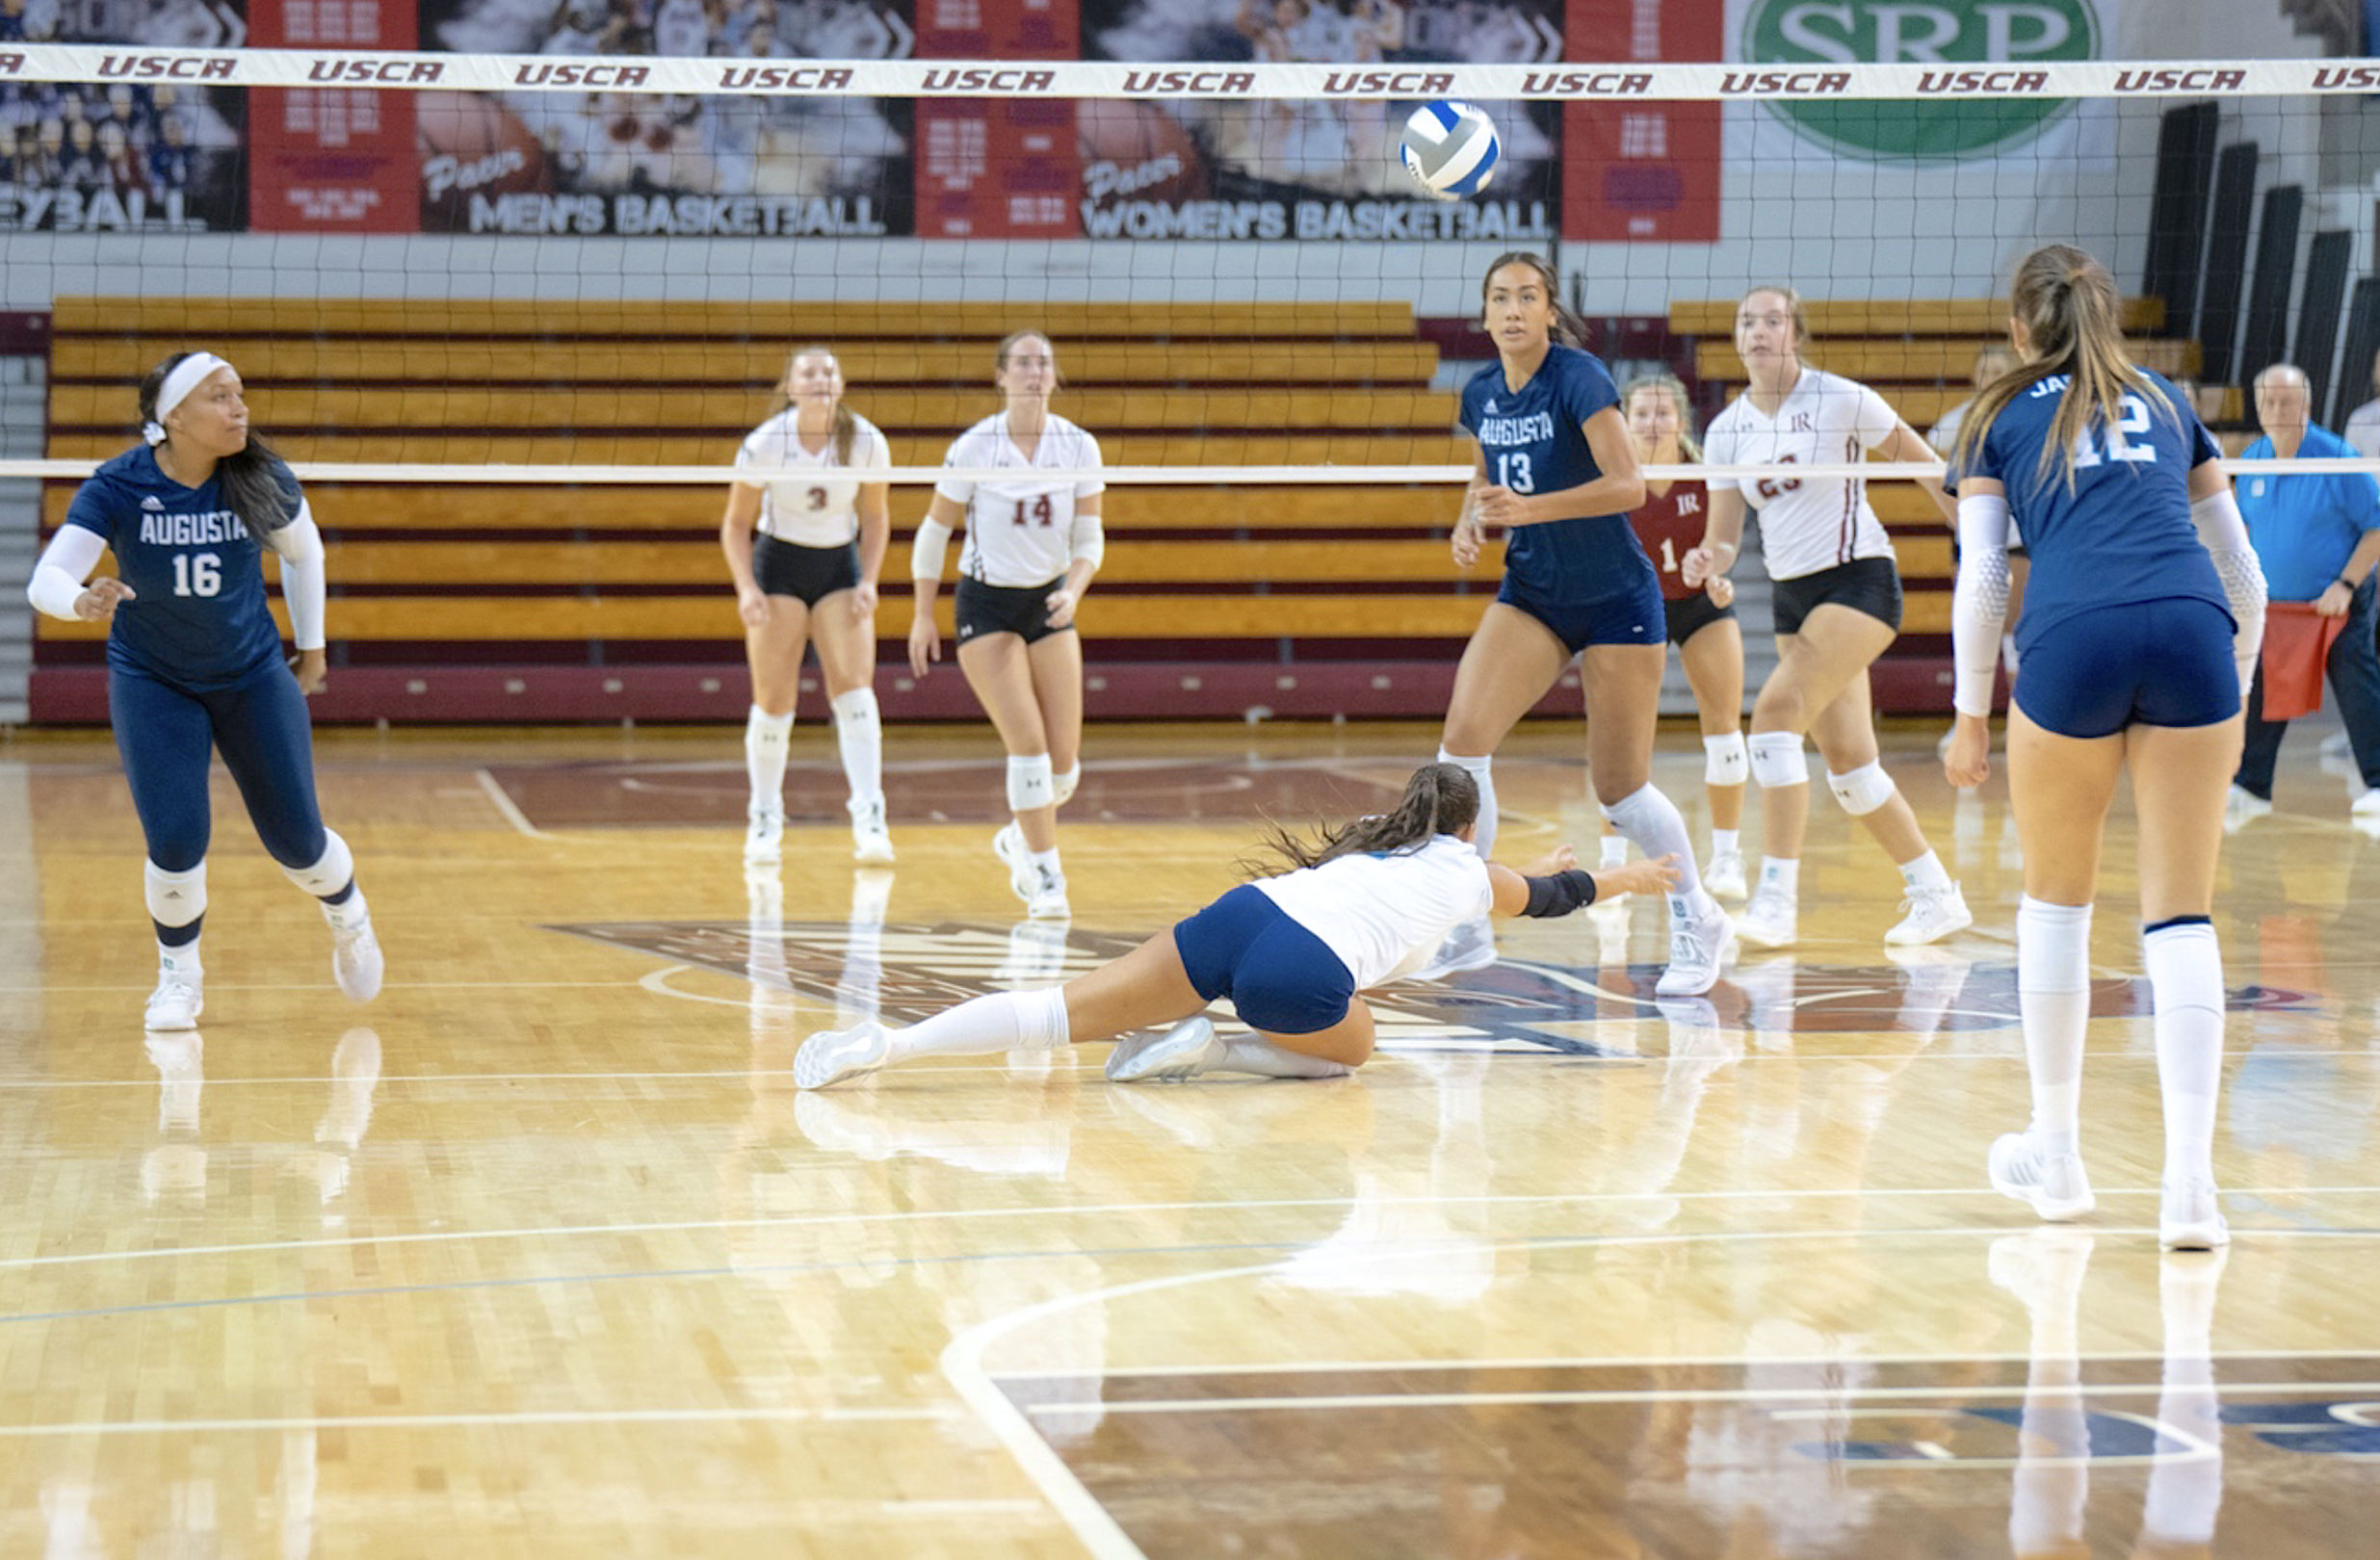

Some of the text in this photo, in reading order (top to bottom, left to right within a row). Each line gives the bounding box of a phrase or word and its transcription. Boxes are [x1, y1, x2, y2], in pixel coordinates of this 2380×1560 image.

[1778, 3, 2071, 64] SRP
[469, 193, 887, 236] MEN'S BASKETBALL
[1080, 198, 1287, 240] WOMEN'S
[1294, 199, 1554, 241] BASKETBALL
[1478, 410, 1555, 447] AUGUSTA
[1498, 452, 1535, 494] 13
[807, 486, 828, 511] 3
[1011, 492, 1052, 527] 14
[140, 510, 249, 545] AUGUSTA
[1661, 536, 1678, 573] 1
[172, 552, 222, 598] 16
